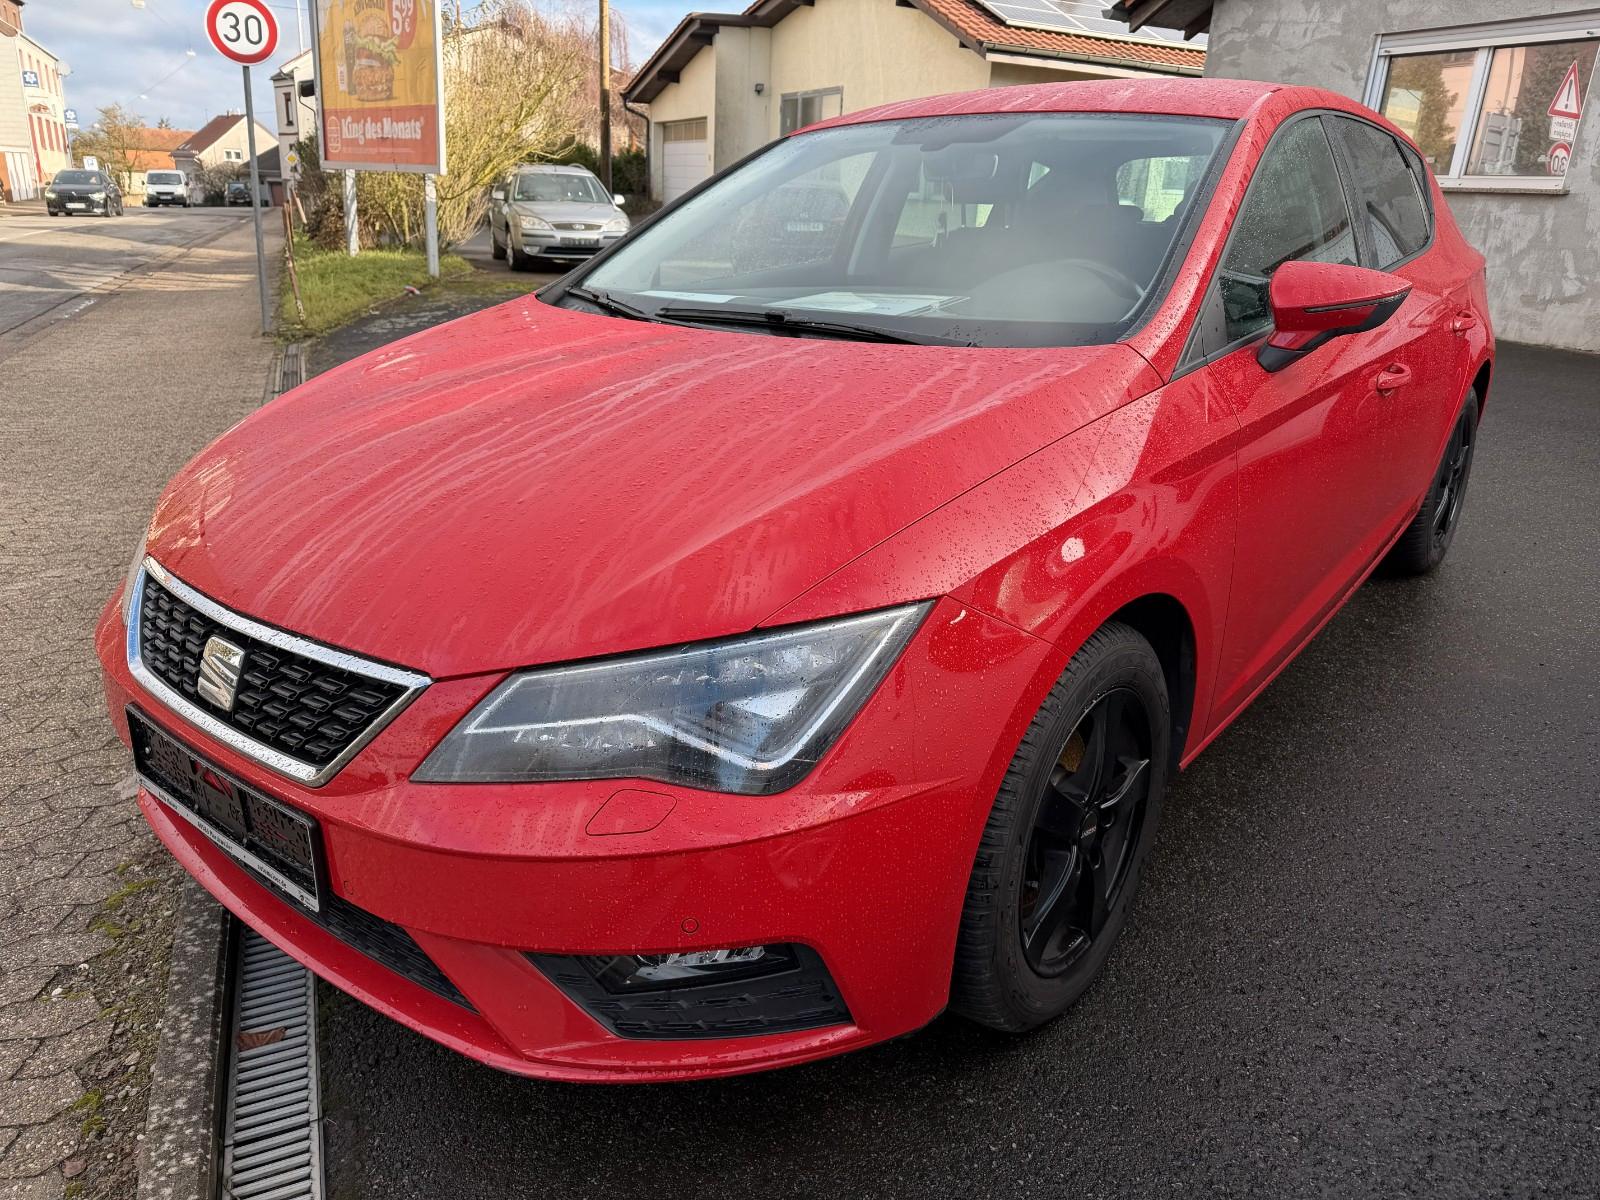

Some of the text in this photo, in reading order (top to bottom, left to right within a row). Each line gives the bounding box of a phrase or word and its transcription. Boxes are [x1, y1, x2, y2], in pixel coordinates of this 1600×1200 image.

[222, 12, 263, 46] 30
[341, 115, 365, 145] King
[365, 116, 382, 140] des
